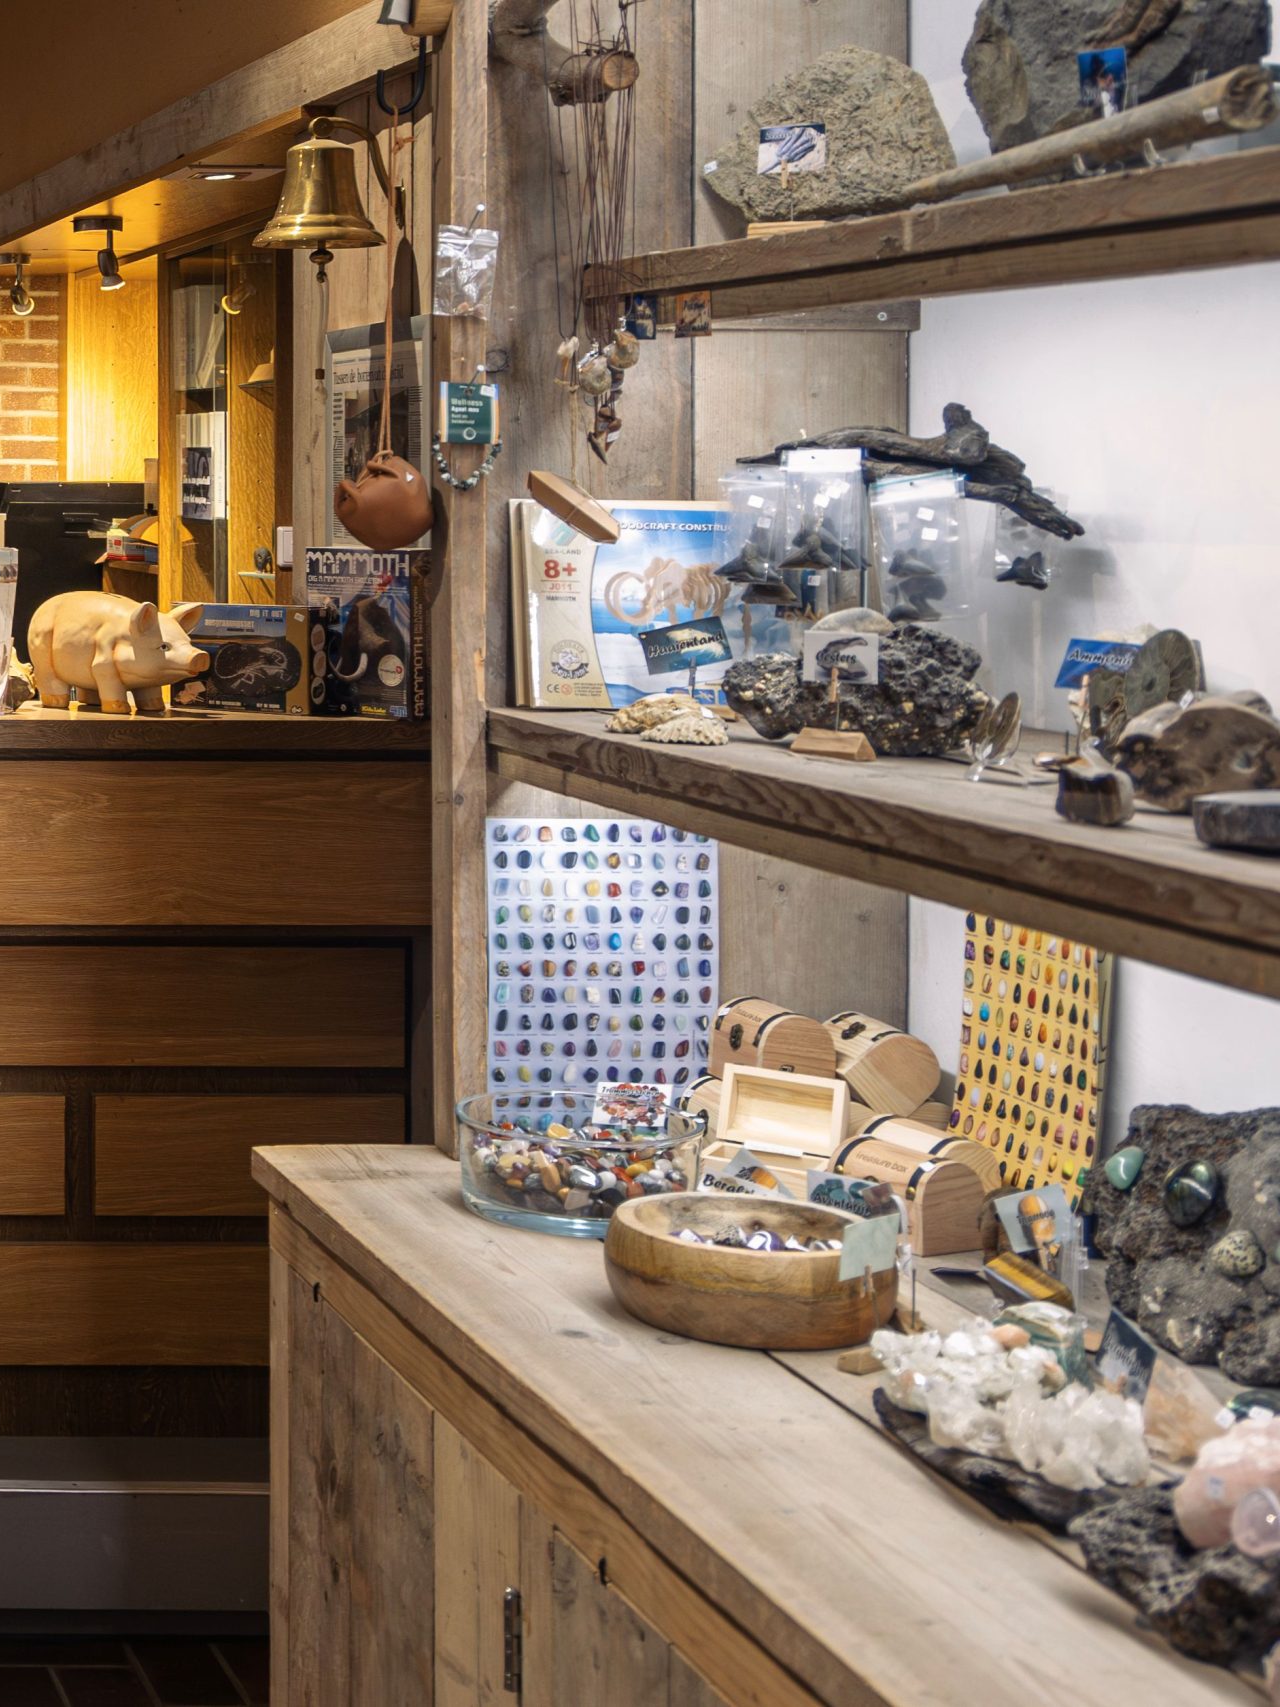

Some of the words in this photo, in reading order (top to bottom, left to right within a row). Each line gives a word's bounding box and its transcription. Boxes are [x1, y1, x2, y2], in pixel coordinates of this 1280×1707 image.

[620, 521, 677, 530] OODCRAFT
[678, 523, 730, 532] CONSTRU
[306, 552, 410, 577] MAMMOTH
[544, 560, 577, 579] 8+
[413, 637, 424, 717] MAMMOTH
